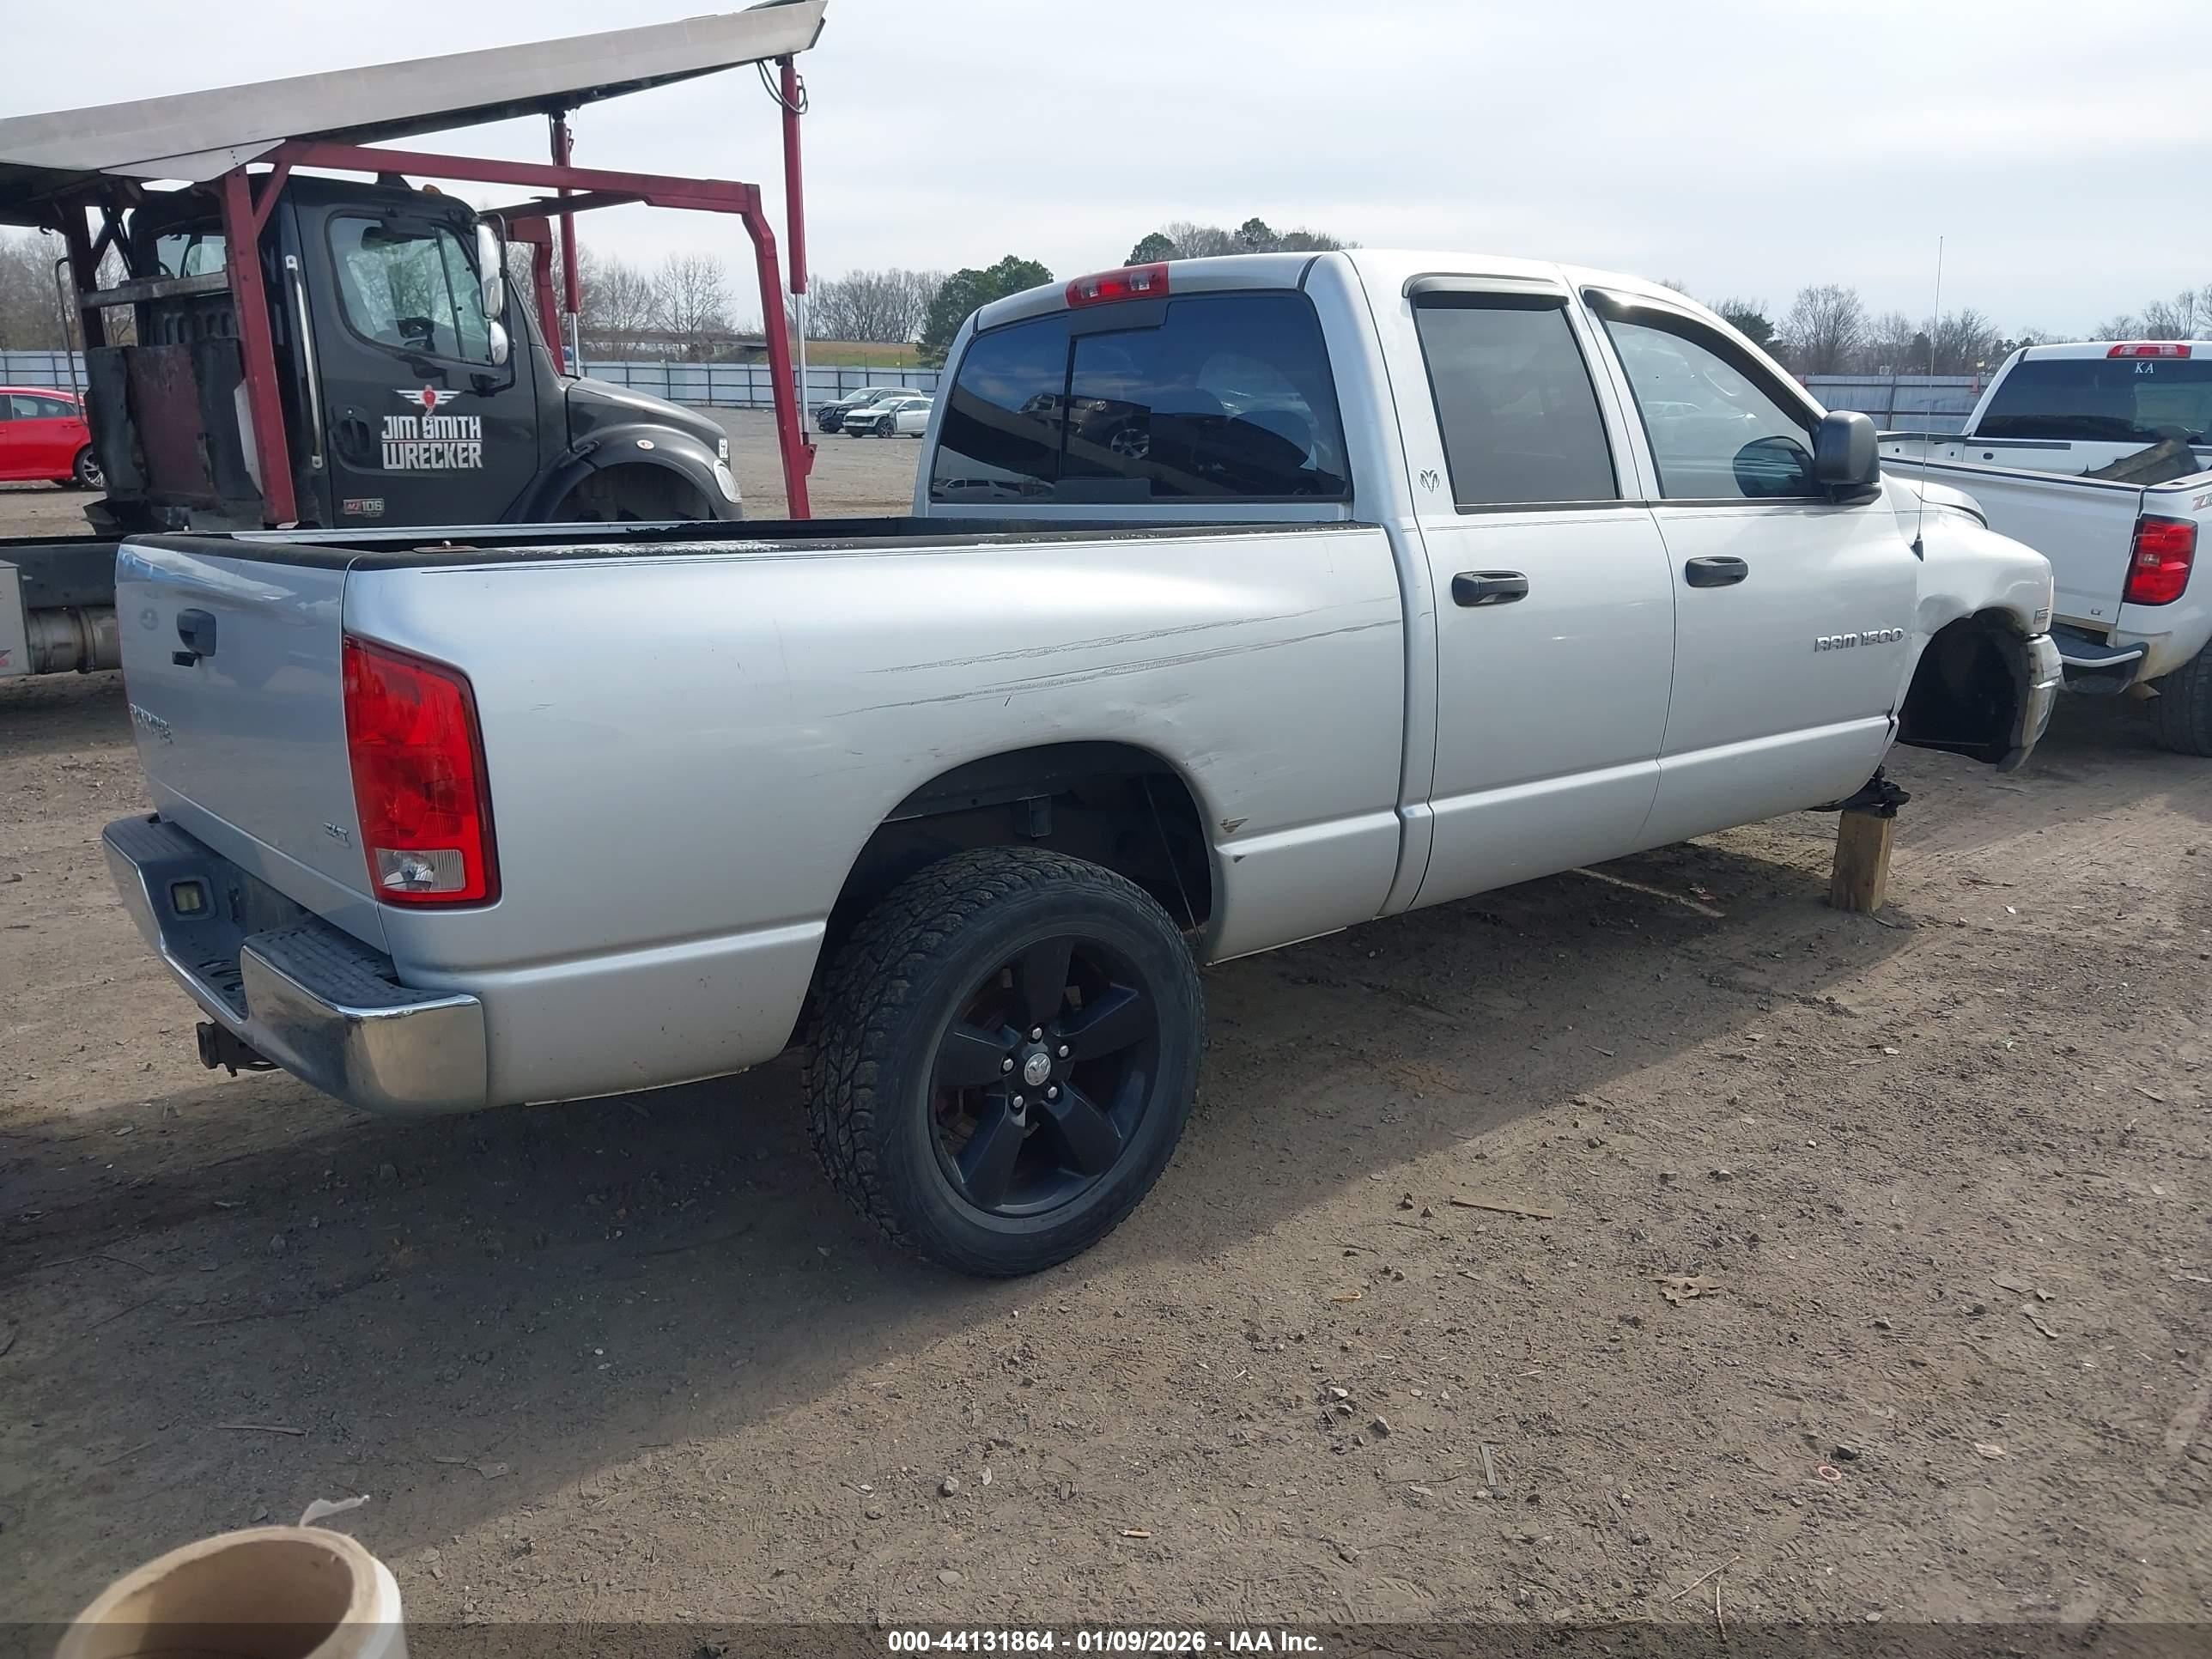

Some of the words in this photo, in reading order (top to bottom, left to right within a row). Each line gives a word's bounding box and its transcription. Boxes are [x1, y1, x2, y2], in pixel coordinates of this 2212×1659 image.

[381, 416, 418, 440] JIM
[422, 416, 482, 440] SMITH
[382, 442, 483, 470] WRECKER
[1814, 633, 1857, 653] RAM
[1861, 628, 1904, 646] 1500
